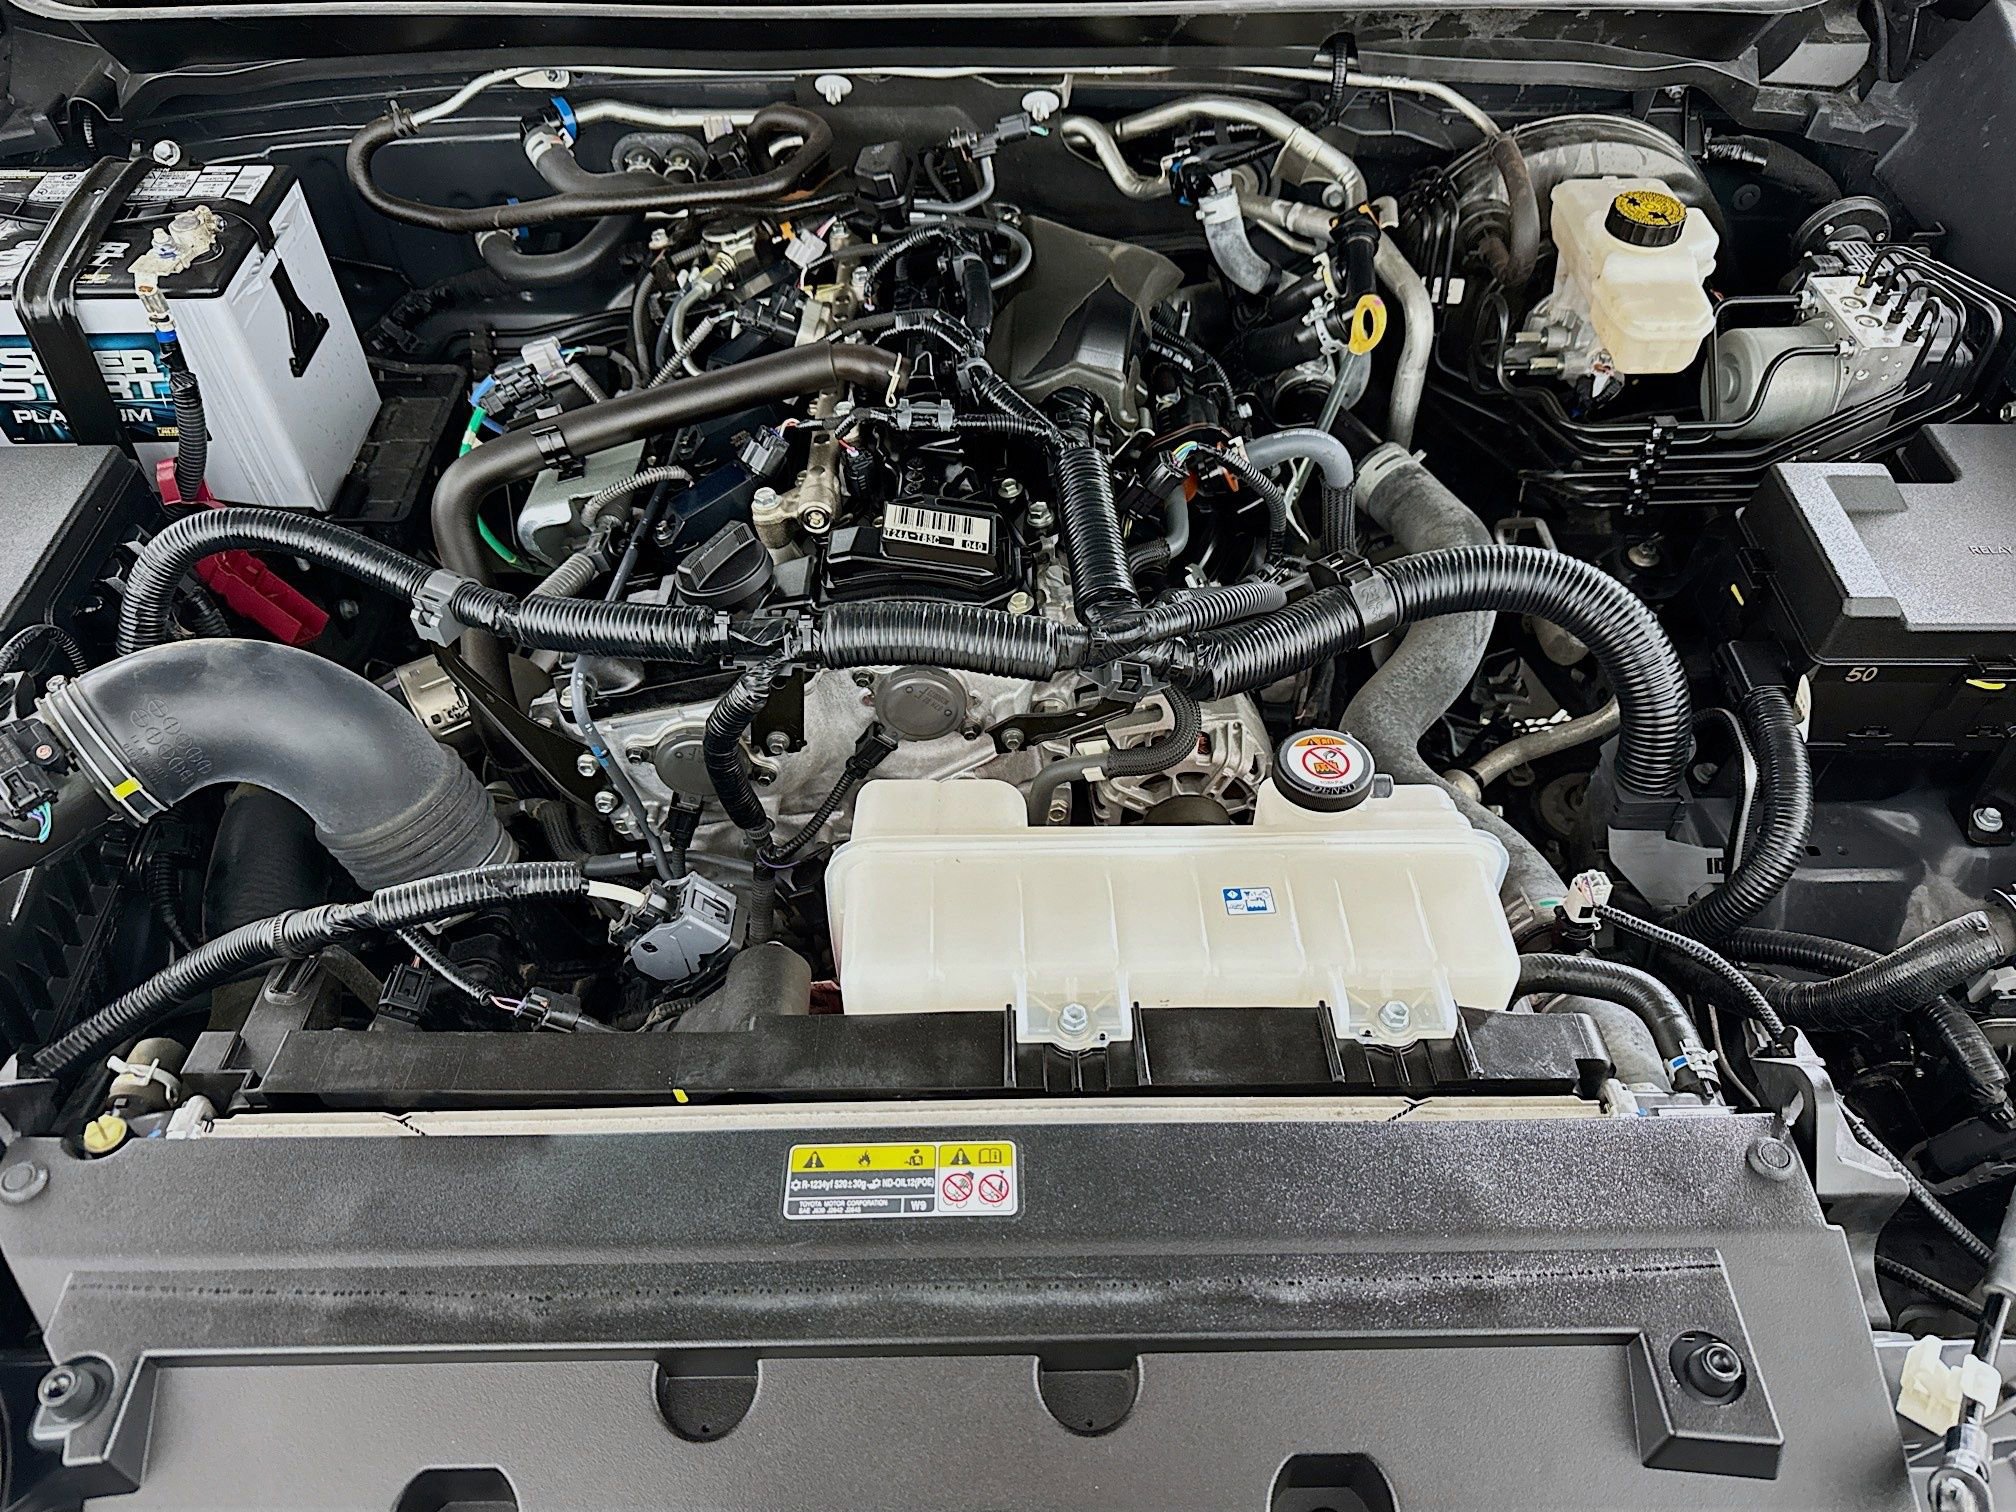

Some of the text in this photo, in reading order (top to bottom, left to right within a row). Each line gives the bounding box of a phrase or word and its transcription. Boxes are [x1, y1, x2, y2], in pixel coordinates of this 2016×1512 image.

[0, 347, 158, 374] SER
[0, 373, 165, 401] STRT
[965, 541, 984, 550] 040
[1968, 545, 2013, 555] RELAY
[1845, 667, 1878, 682] 50
[1311, 783, 1356, 794] DENSO
[799, 1199, 928, 1211] TOYOTA MOTOR CORPORATION W9
